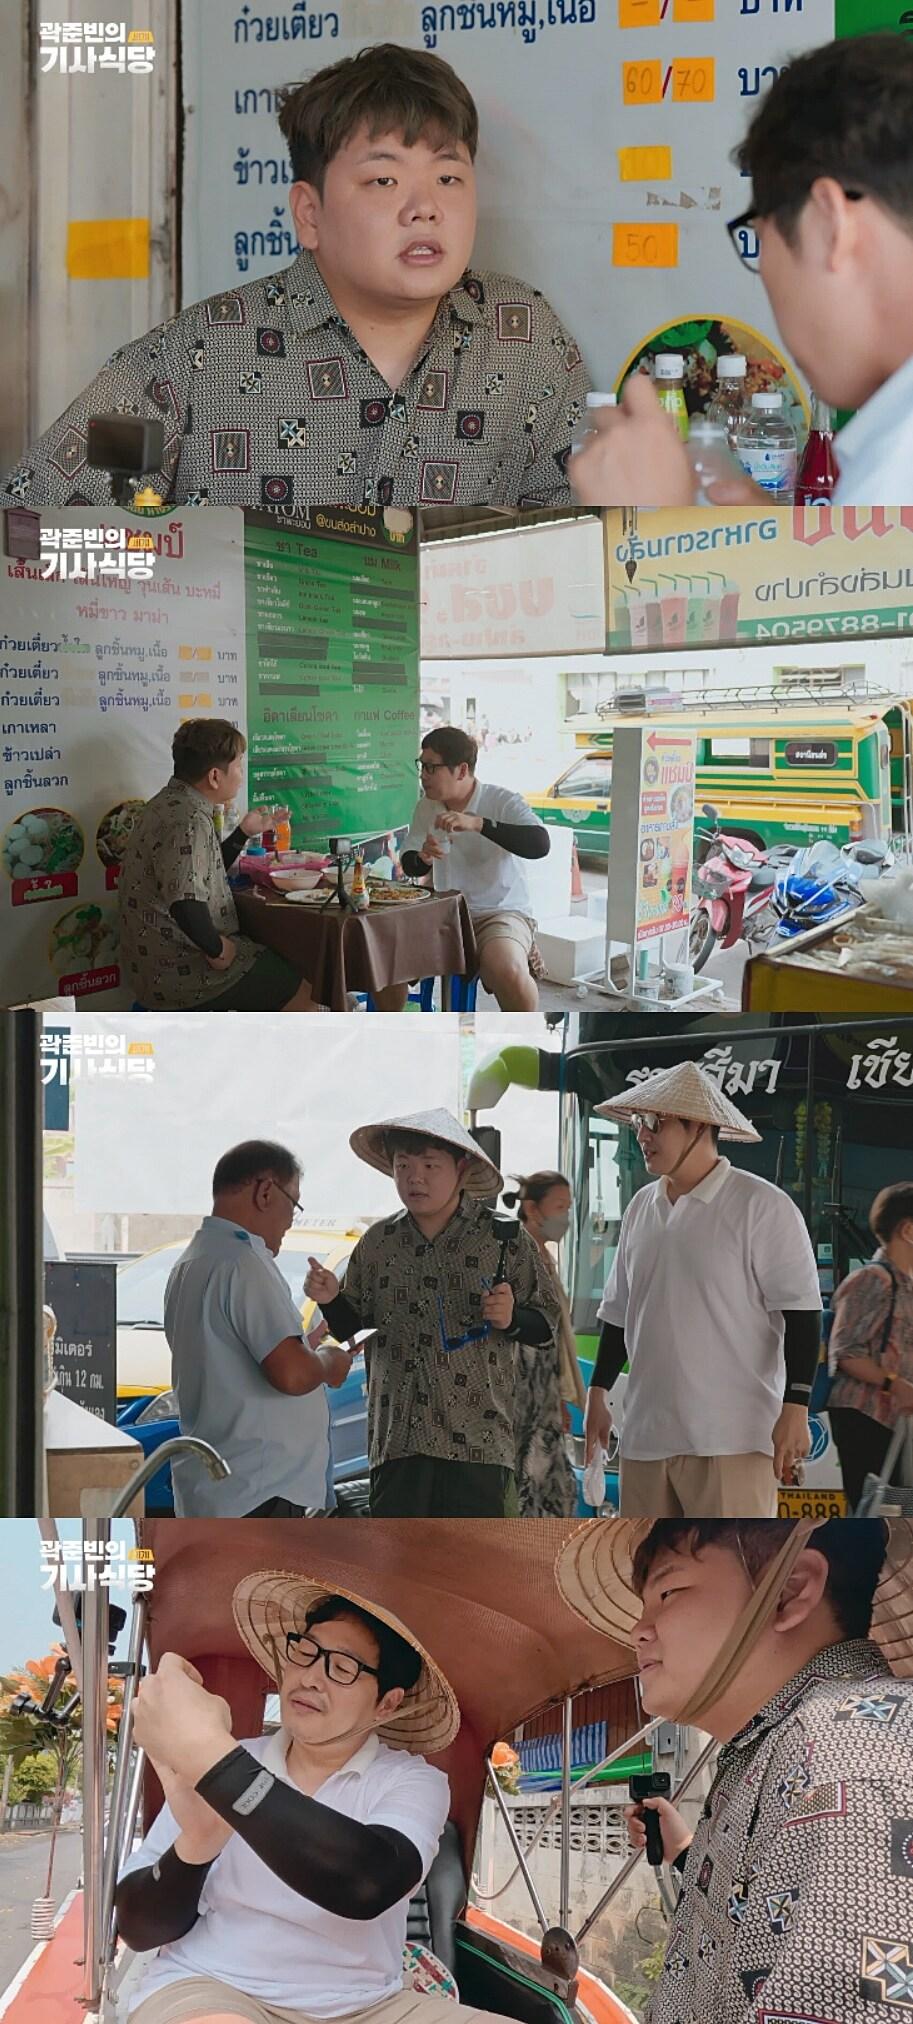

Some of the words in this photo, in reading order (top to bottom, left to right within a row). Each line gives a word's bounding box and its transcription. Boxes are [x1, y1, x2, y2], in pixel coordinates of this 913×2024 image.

[234, 0, 339, 43] ก๋วยเตียว
[421, 0, 596, 48] ลูกชนหมู,เนอ
[737, 65, 791, 96] บา
[233, 206, 299, 271] ลูกชิ้น
[625, 233, 657, 262] 50
[298, 542, 318, 558] Tea
[384, 709, 415, 721] Coffee
[2, 721, 57, 735] เกาเหลา
[4, 769, 69, 796] ลูกชิ้นลวก
[75, 1369, 87, 1388] 12
[780, 1491, 836, 1500] THAILAND
